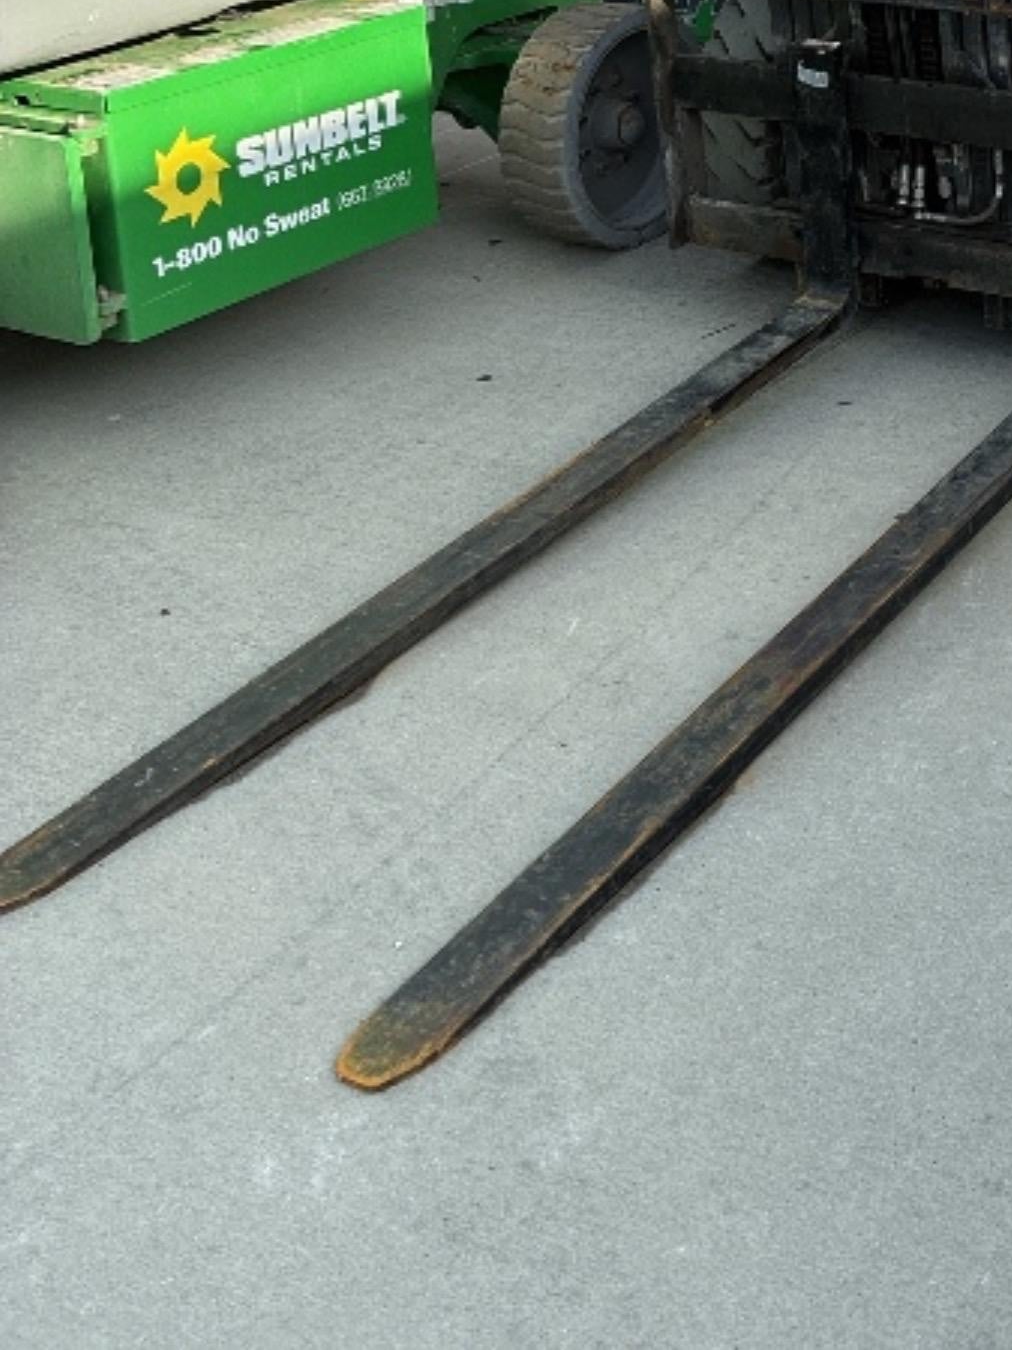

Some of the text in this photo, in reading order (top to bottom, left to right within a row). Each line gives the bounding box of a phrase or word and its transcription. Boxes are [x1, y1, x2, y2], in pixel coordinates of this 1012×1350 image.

[236, 89, 402, 178] SUNBELT
[264, 134, 382, 188] RENTALS
[152, 236, 223, 278] 1-800
[227, 225, 259, 250] No
[263, 197, 331, 238] Sweat
